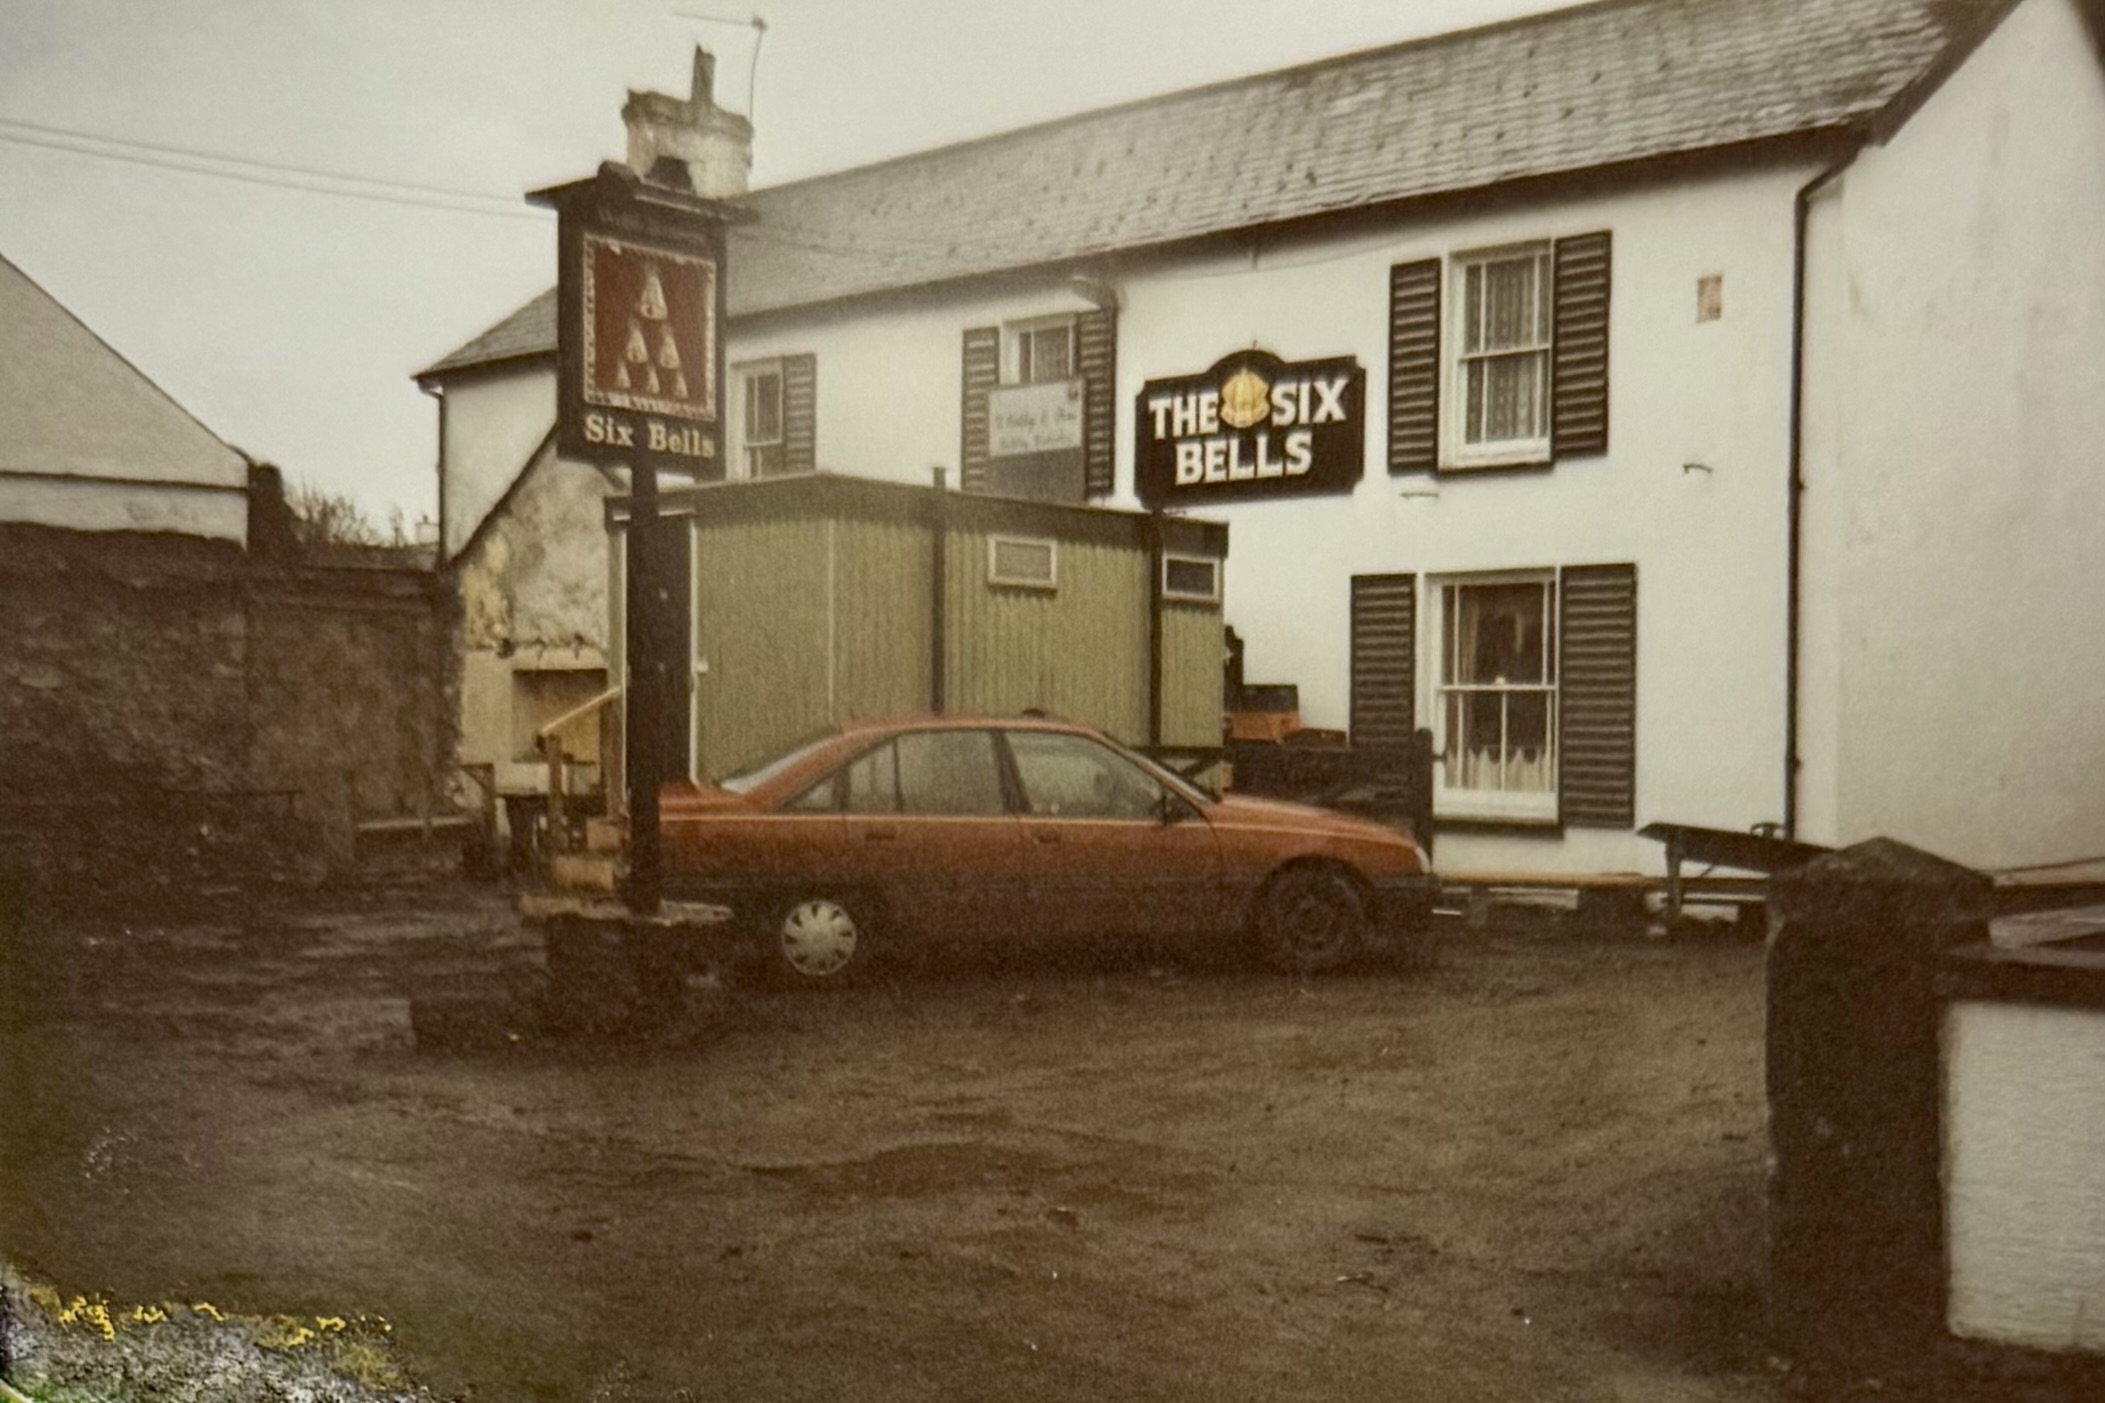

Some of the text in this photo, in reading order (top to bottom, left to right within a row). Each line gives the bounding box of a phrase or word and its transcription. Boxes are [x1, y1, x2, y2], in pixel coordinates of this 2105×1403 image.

[584, 413, 715, 458] Six Bells
[1148, 377, 1348, 440] THE SIX
[1175, 431, 1313, 485] BELLS
